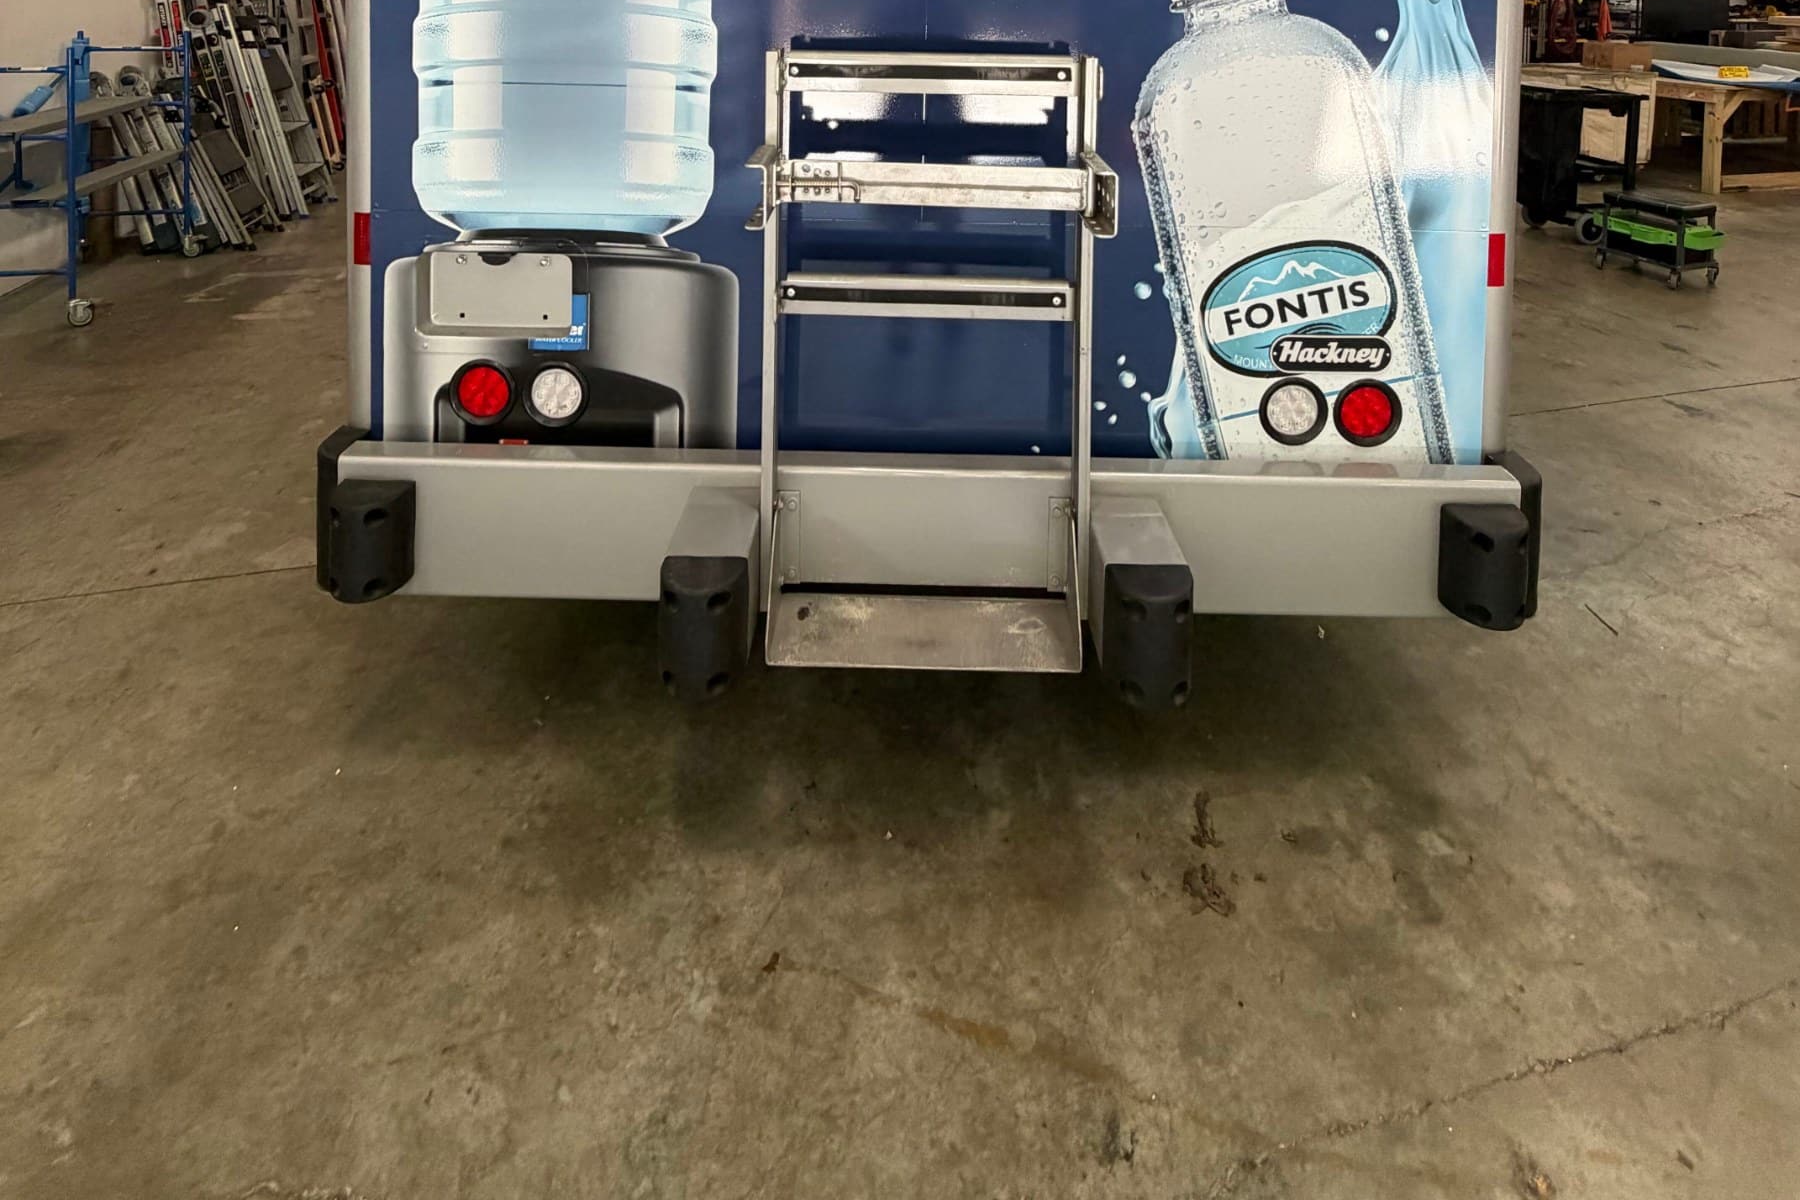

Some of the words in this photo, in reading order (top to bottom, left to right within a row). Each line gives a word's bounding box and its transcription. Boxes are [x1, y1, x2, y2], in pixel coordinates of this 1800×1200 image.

[1223, 280, 1371, 336] FONTIS
[1233, 354, 1274, 369] MOUNT
[1278, 341, 1386, 369] Hackney
